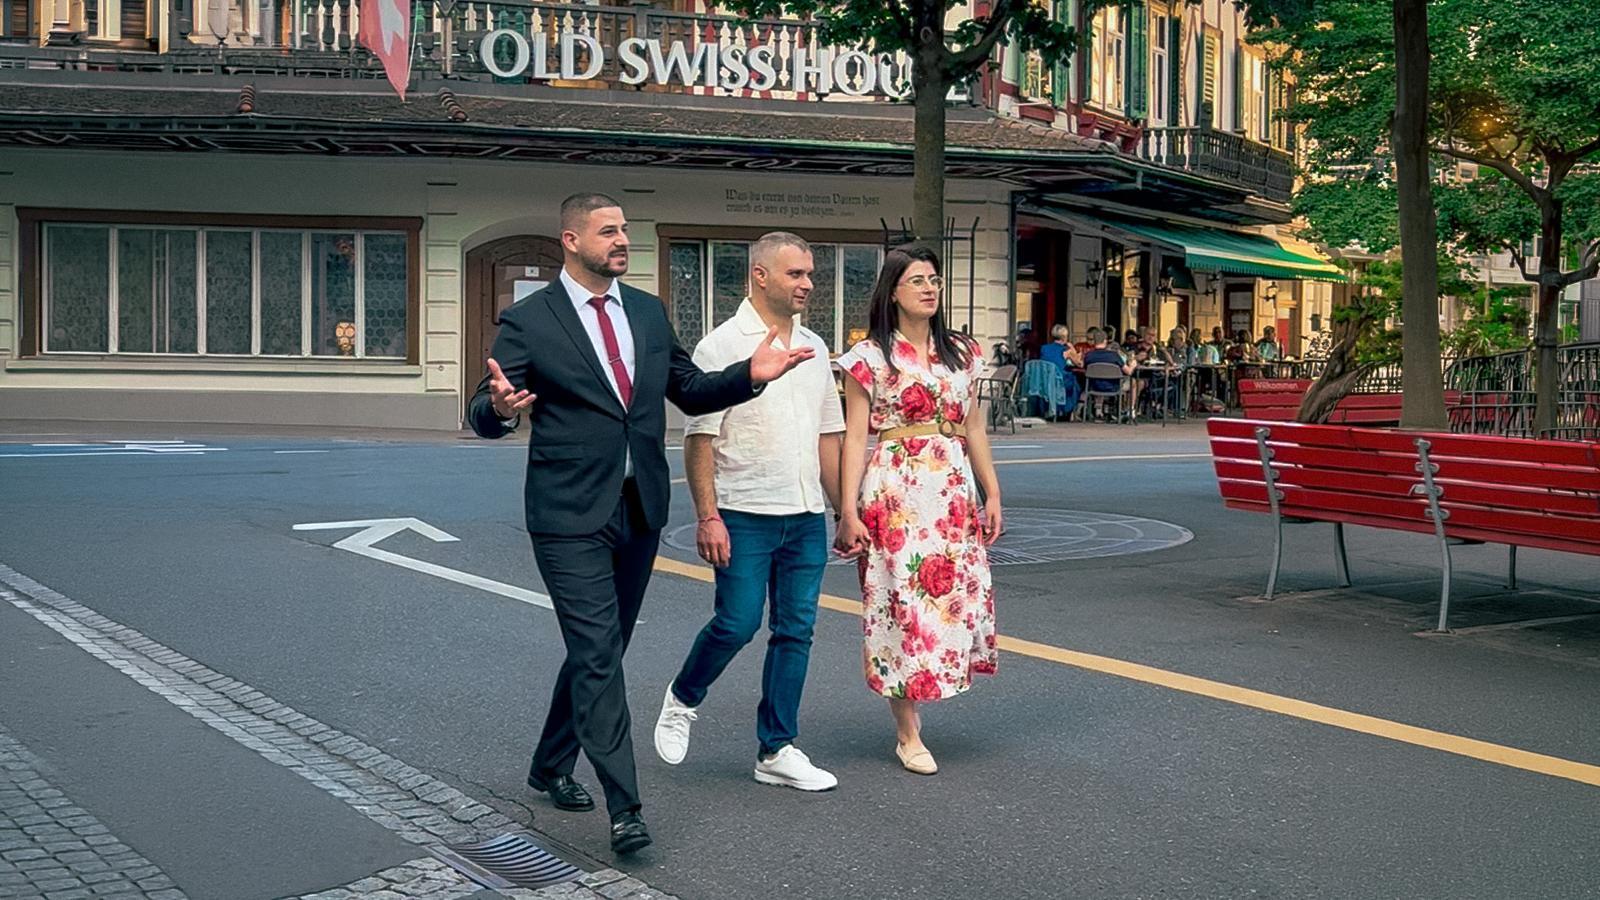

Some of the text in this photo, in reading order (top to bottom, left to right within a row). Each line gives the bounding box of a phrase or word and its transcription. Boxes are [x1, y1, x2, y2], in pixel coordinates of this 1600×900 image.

[480, 28, 969, 100] OLD SWISS HOU
